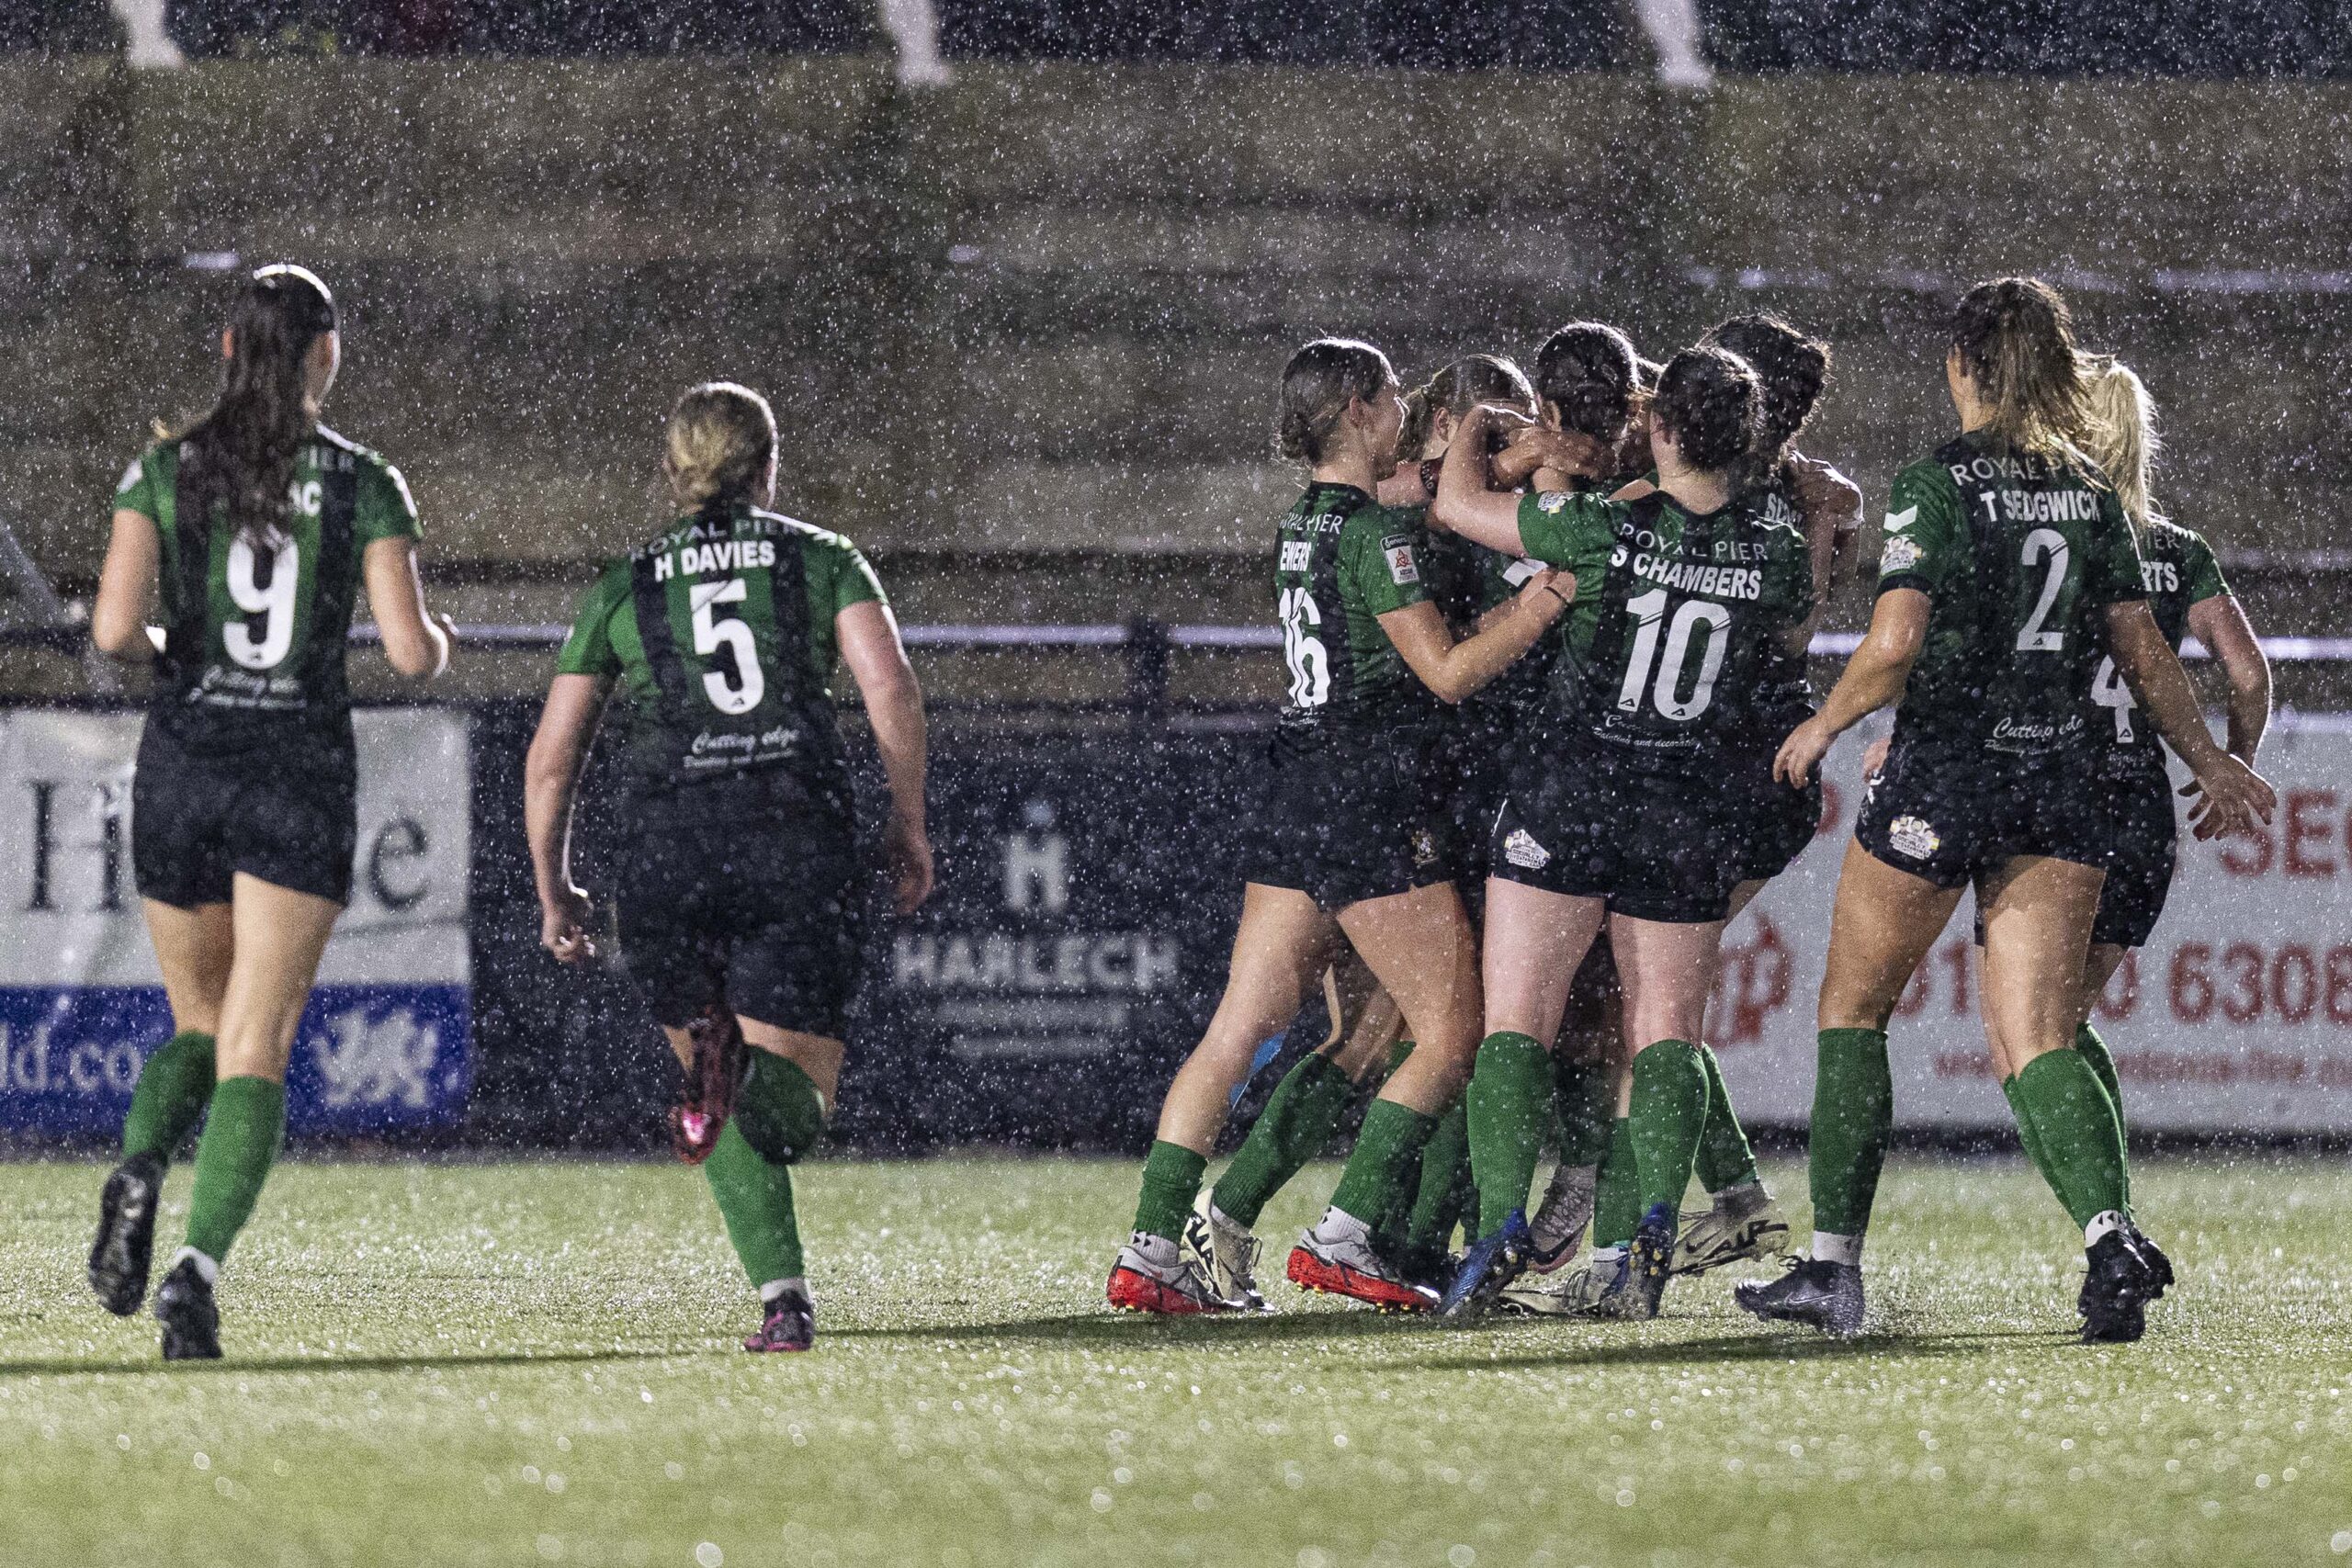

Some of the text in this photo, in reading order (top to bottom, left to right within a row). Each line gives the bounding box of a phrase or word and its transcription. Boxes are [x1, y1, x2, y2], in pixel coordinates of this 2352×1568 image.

[1949, 457, 2044, 487] ROYAL
[1979, 489, 2102, 523] T SEDGWICK
[654, 539, 776, 583] H DAVIES
[1611, 544, 1762, 601] S CHAMBERS
[1619, 522, 1770, 562] ROYAL PIER
[223, 525, 299, 670] 9
[2016, 527, 2069, 651] 2
[689, 577, 765, 716] 5
[1278, 586, 1331, 709] 16
[1616, 588, 1732, 721] 10
[2089, 654, 2139, 744] 4
[896, 936, 1178, 990] HARLECH
